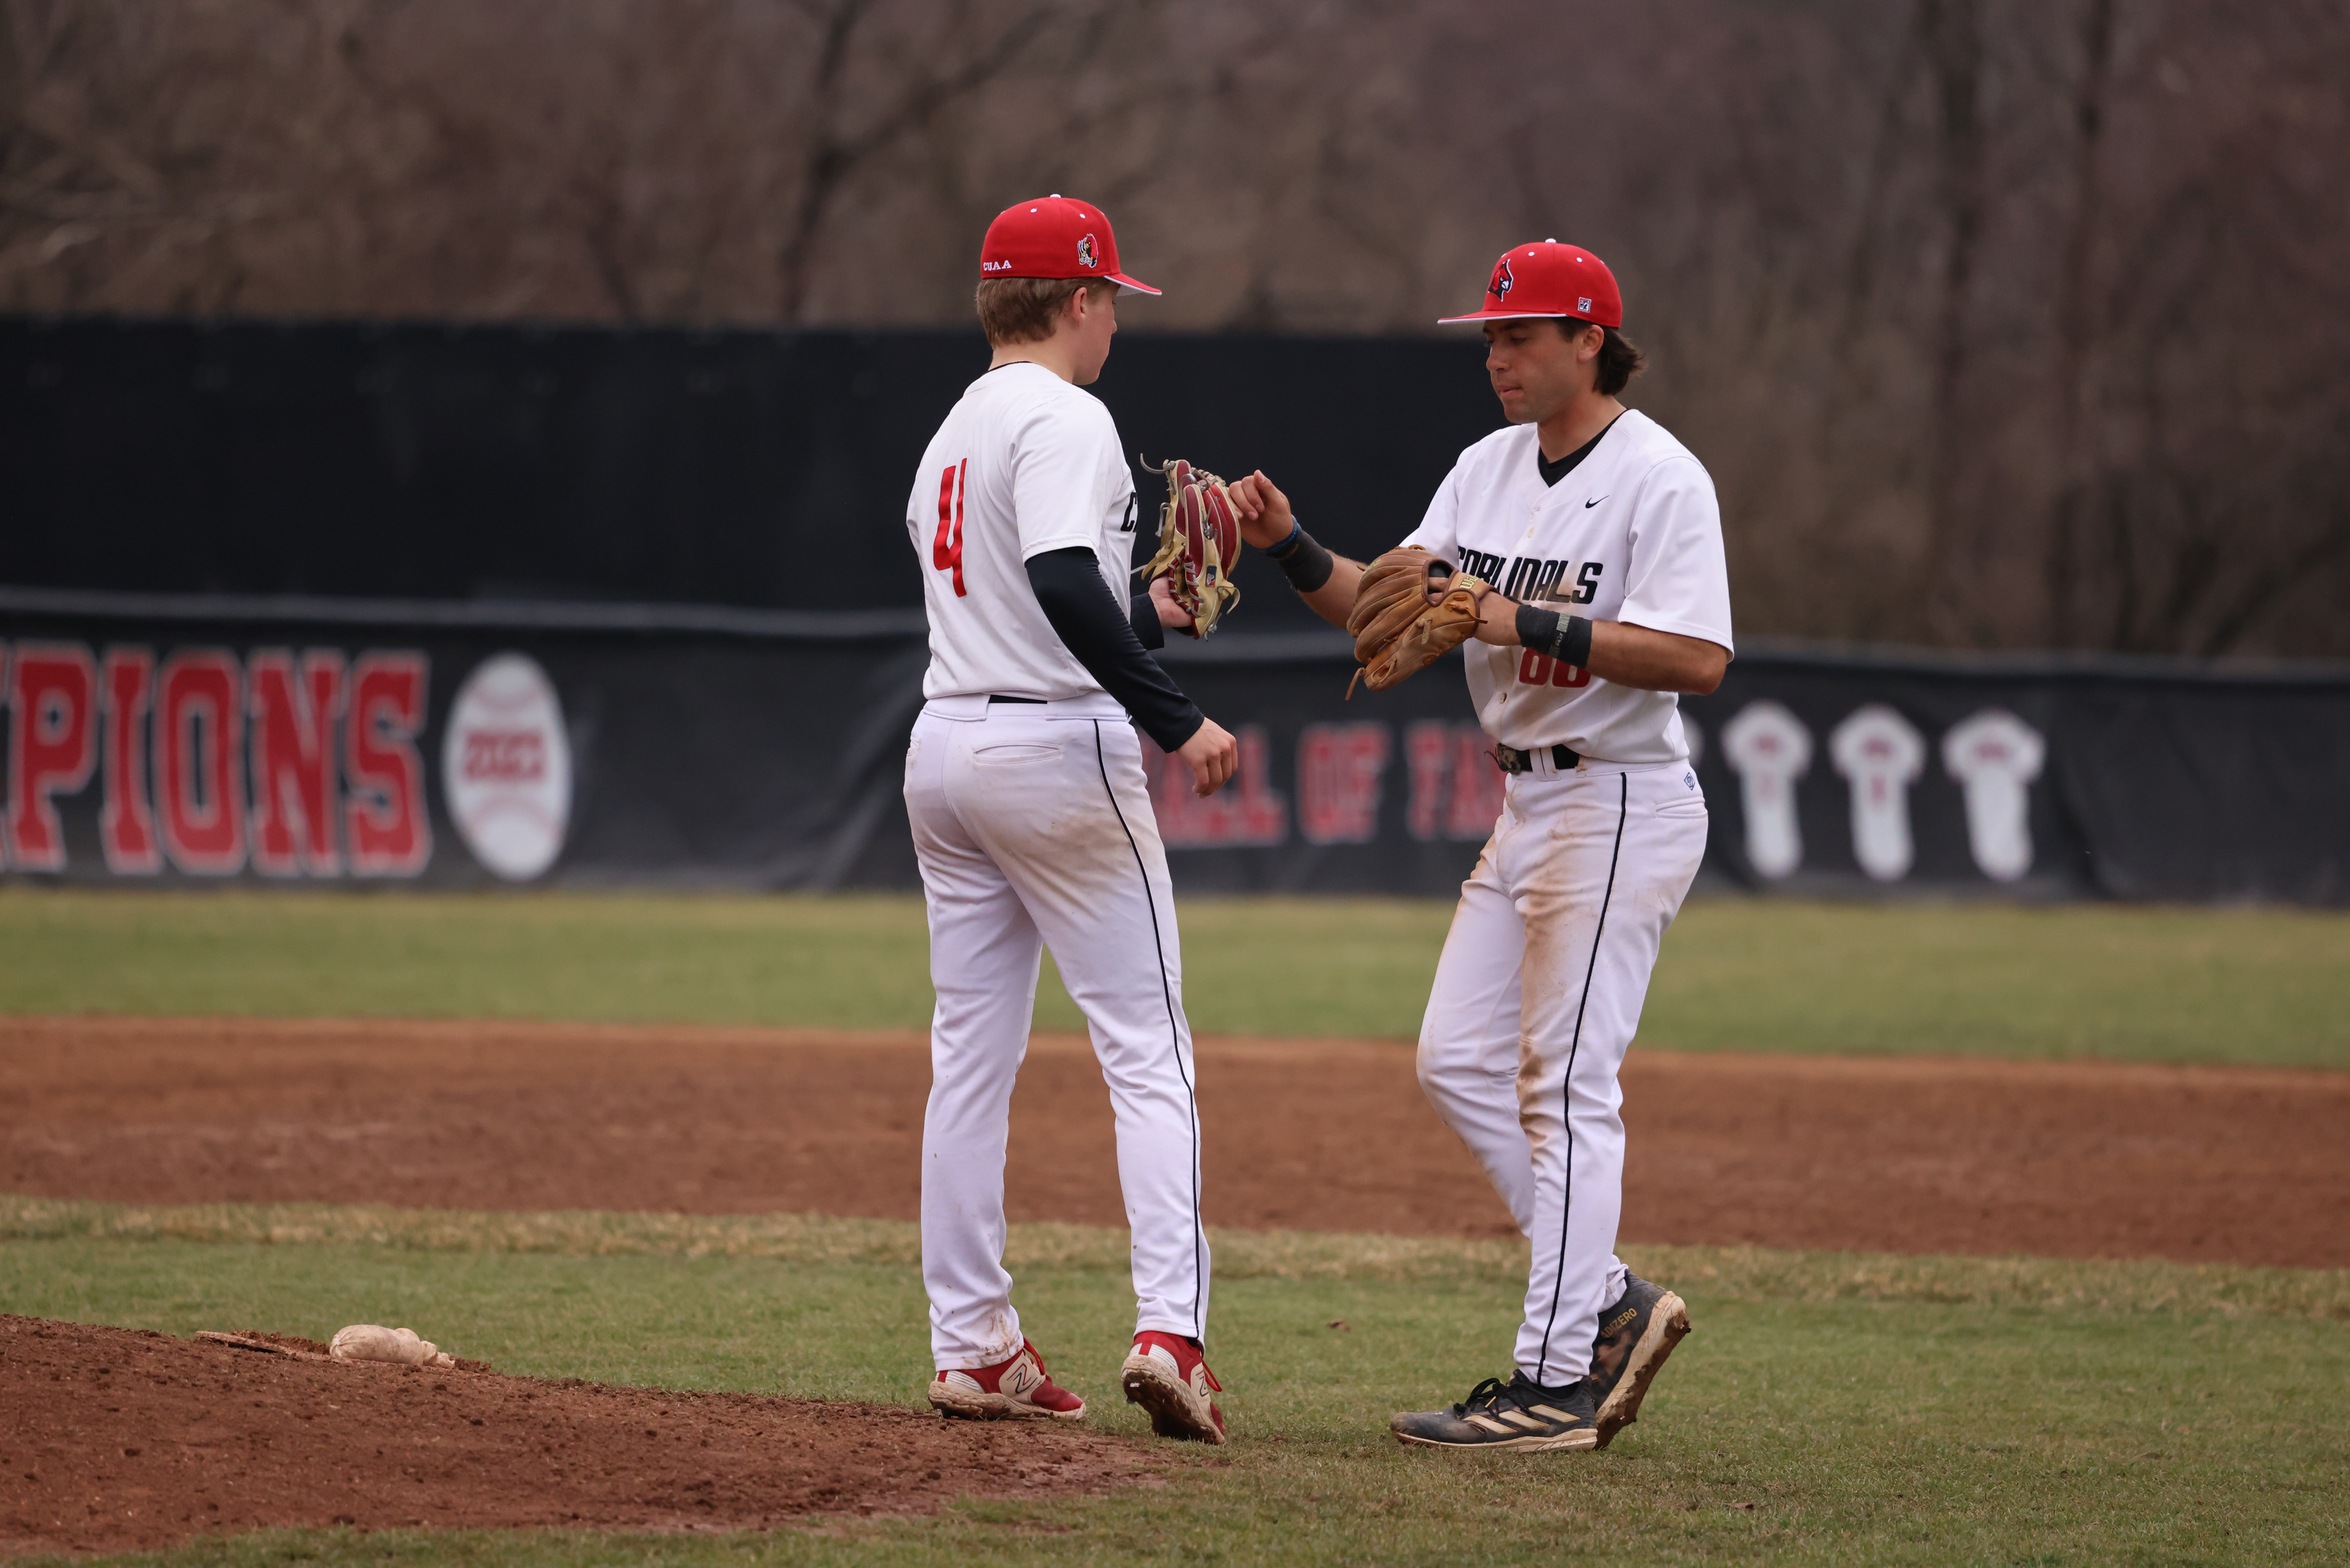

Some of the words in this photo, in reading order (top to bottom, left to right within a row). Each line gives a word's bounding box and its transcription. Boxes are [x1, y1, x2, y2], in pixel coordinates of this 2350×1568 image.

[983, 260, 1012, 271] CUAA
[933, 457, 967, 598] 4
[1120, 491, 1138, 532] C
[0, 640, 433, 878] PIONS
[1298, 719, 1390, 845] OF
